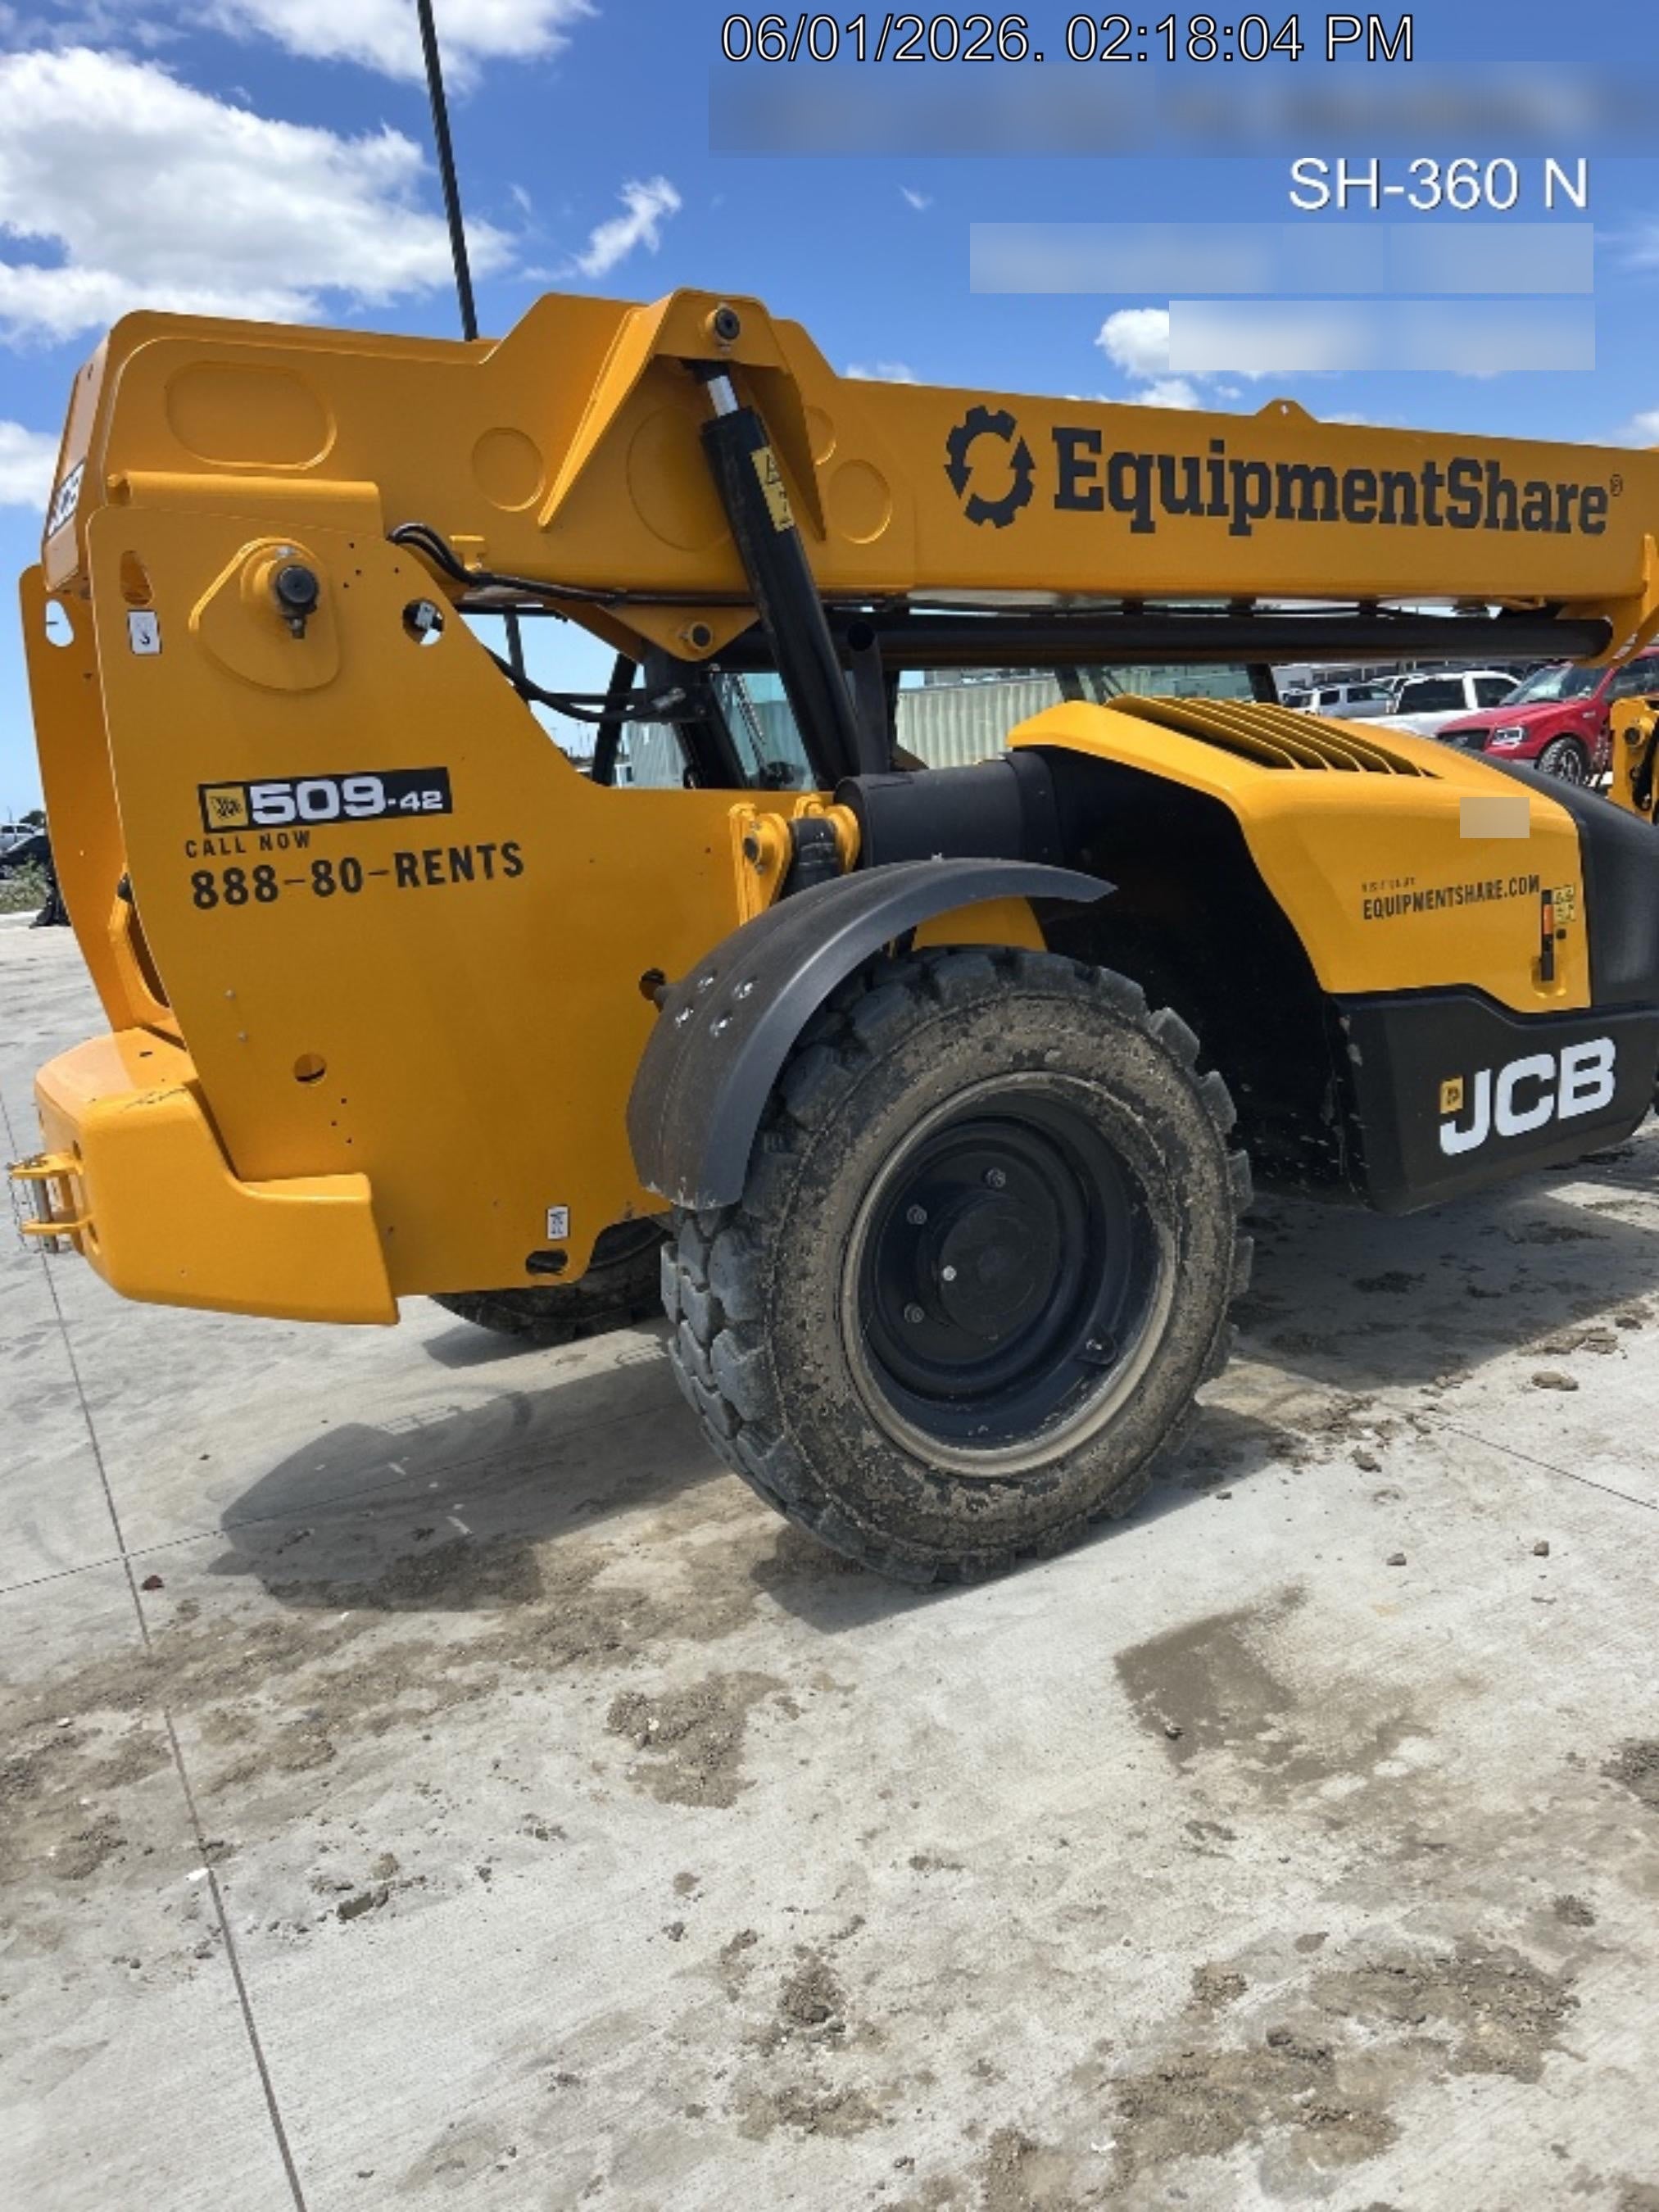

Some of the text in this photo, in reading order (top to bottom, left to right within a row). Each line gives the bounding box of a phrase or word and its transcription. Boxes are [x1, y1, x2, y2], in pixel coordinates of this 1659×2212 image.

[249, 776, 443, 824] 509-42
[184, 829, 311, 859] CALL NOW
[190, 840, 524, 910] 888-80-RENTS
[1439, 1037, 1616, 1155] JCB
